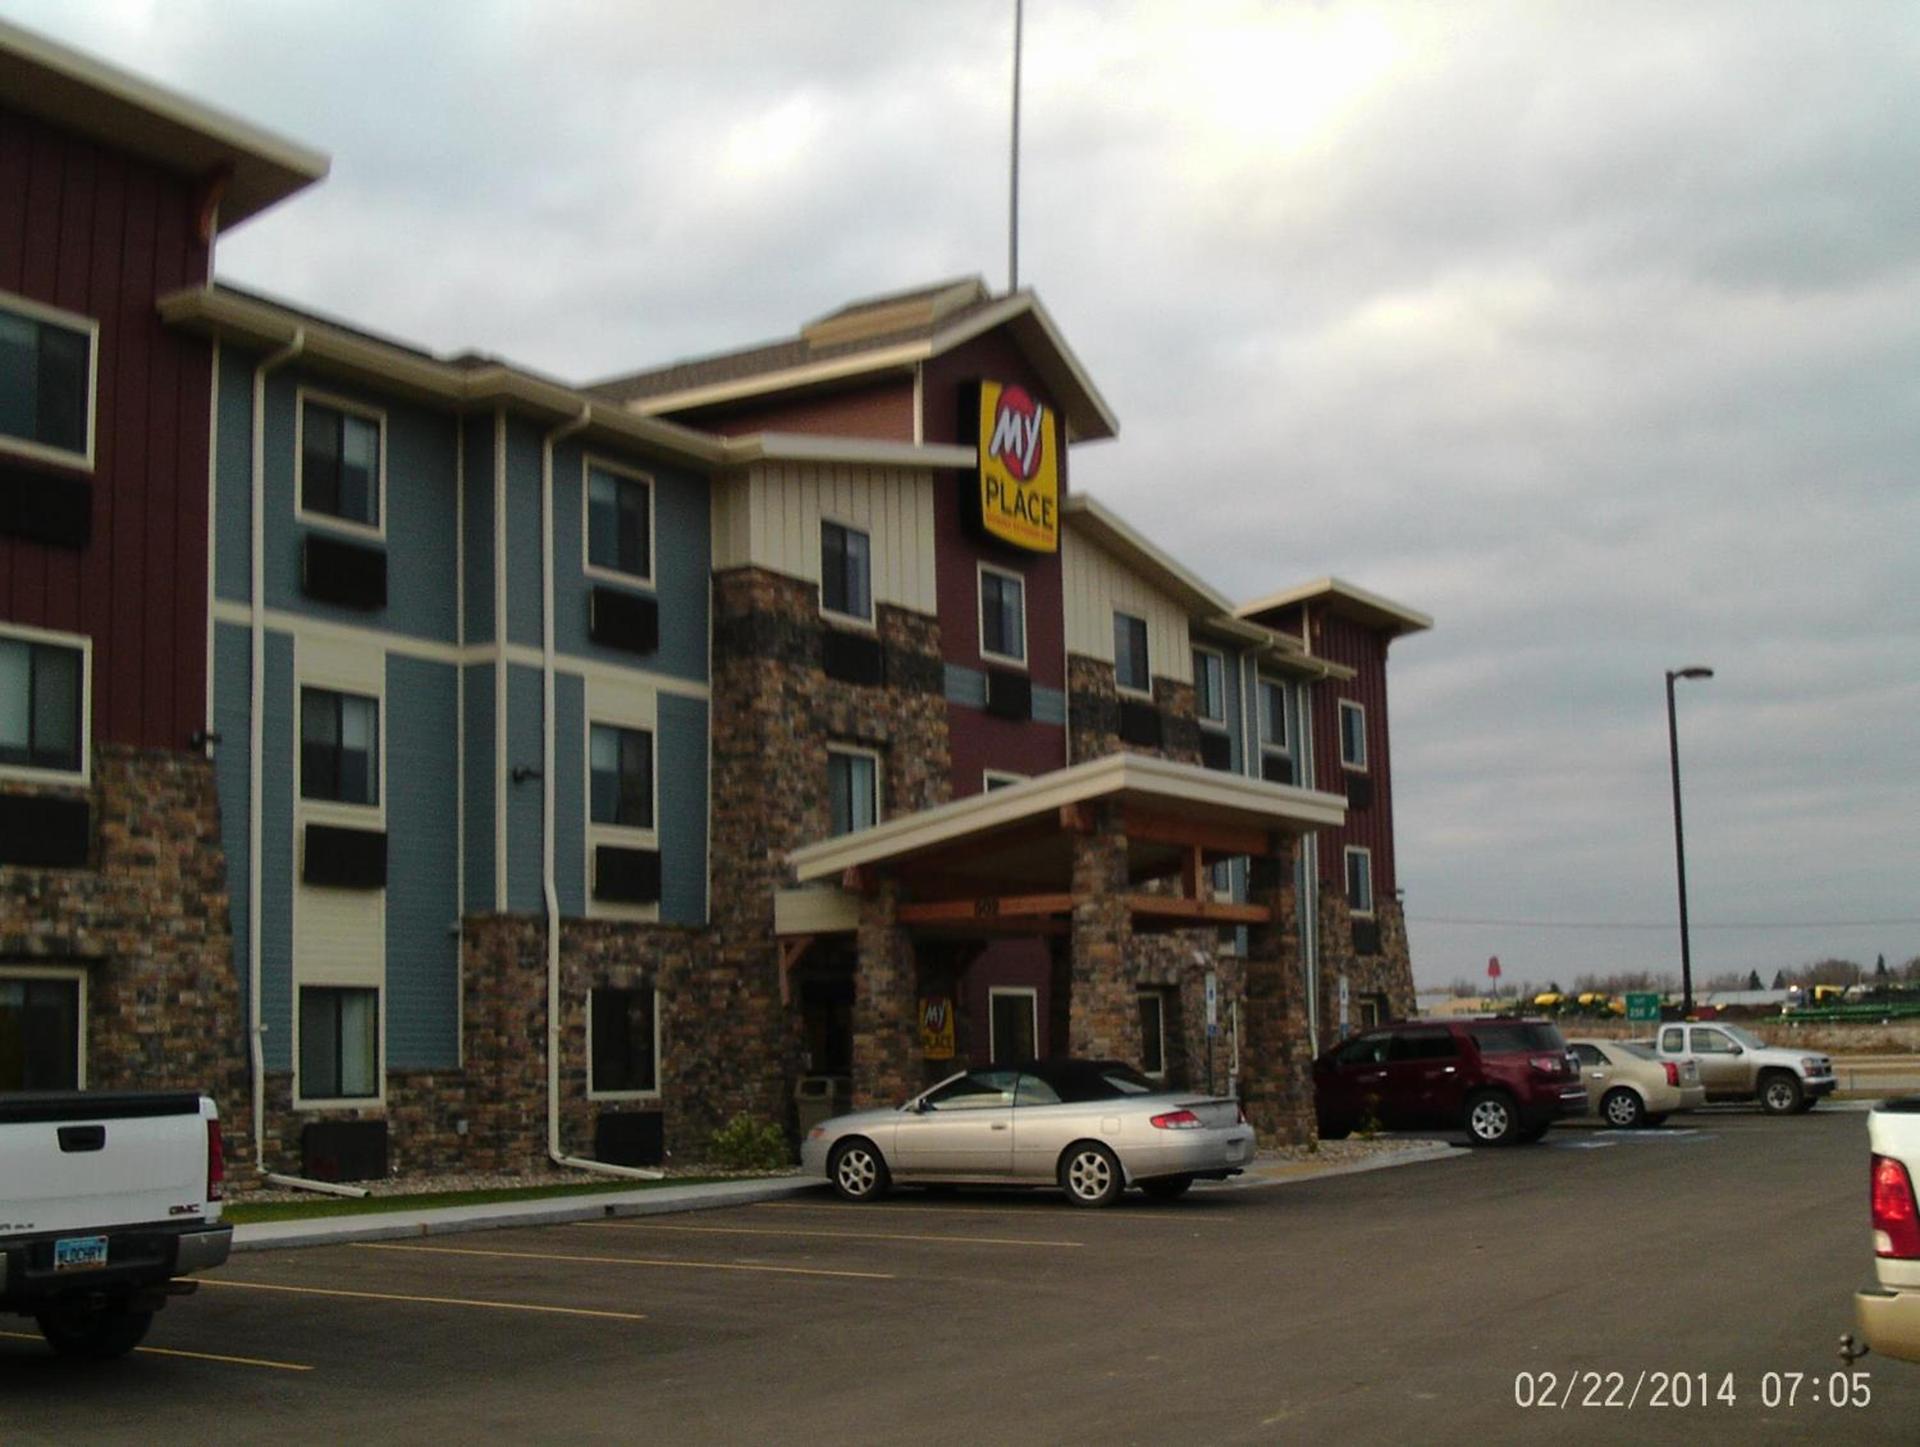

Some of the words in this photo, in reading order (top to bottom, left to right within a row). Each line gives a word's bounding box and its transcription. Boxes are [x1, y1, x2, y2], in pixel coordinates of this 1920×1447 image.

[990, 402, 1043, 477] MY
[985, 475, 1054, 528] PLACE
[168, 1203, 201, 1216] GMC
